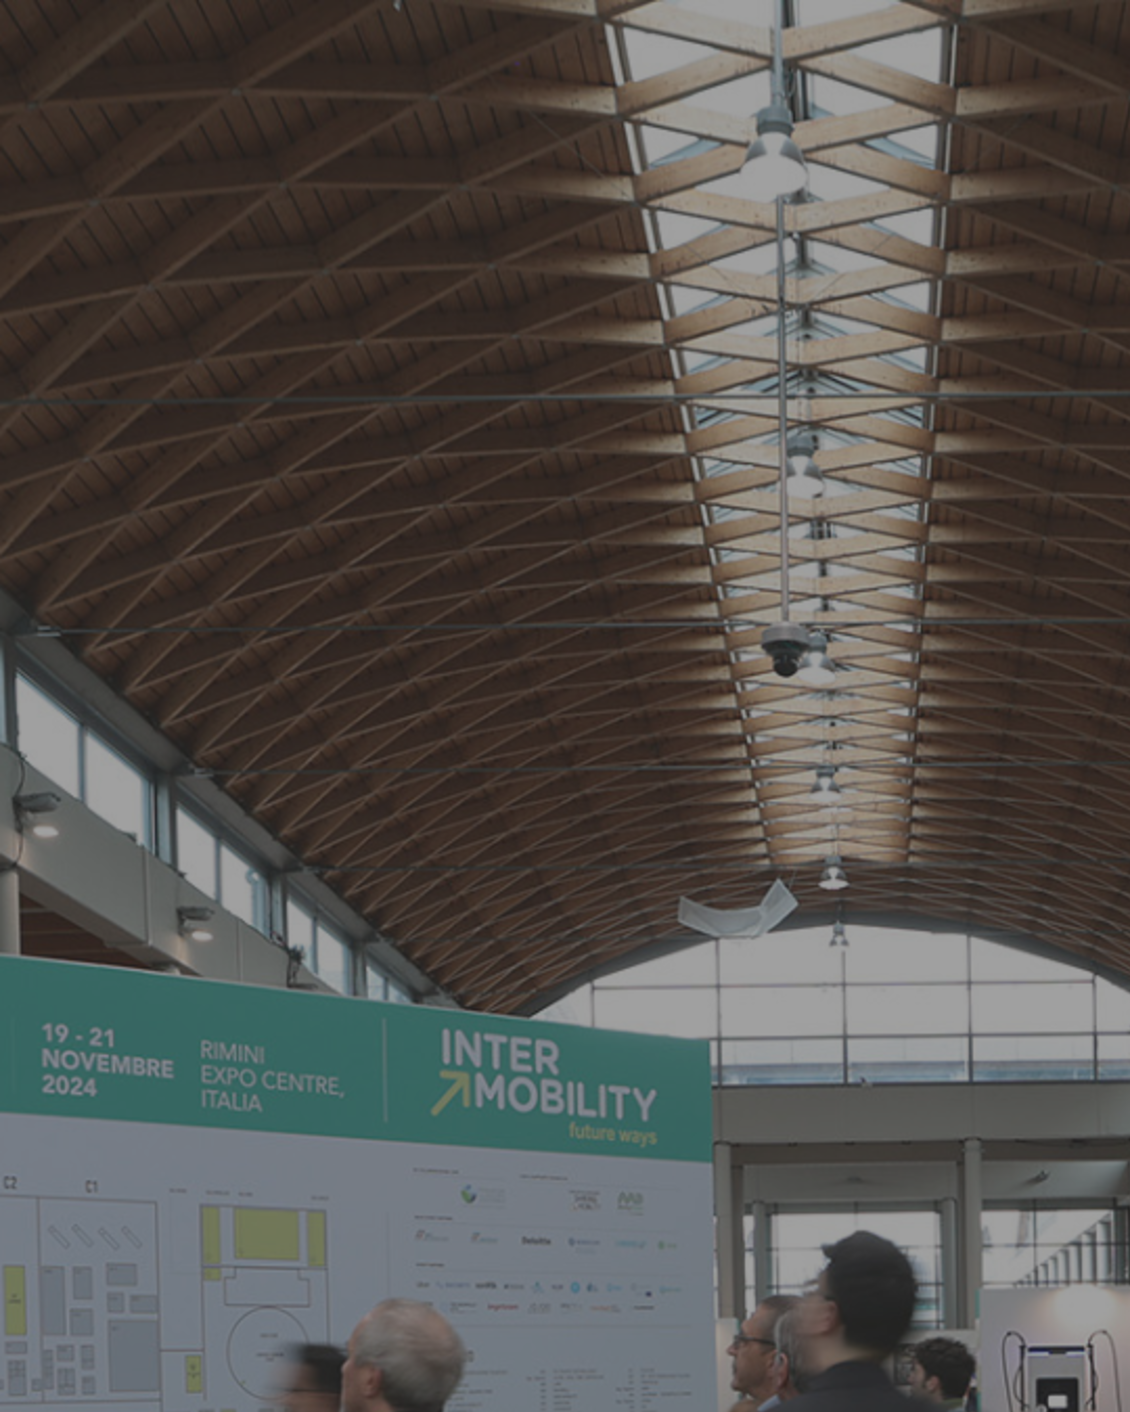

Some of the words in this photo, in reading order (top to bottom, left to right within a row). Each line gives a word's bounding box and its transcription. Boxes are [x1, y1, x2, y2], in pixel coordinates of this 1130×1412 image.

[42, 1023, 69, 1043] 19
[89, 1026, 114, 1048] 21
[41, 1048, 174, 1079] NOVEMBRE
[200, 1040, 265, 1064] RIMINI
[442, 1028, 559, 1076] INTER
[42, 1075, 98, 1097] 2024
[201, 1064, 257, 1089] EXPO
[262, 1070, 345, 1098] CENTRE,
[201, 1090, 263, 1112] ITALIA
[475, 1074, 657, 1122] MOBILITY
[569, 1121, 615, 1142] future
[618, 1130, 658, 1148] ways
[3, 1176, 18, 1190] C2
[84, 1180, 99, 1193] C1
